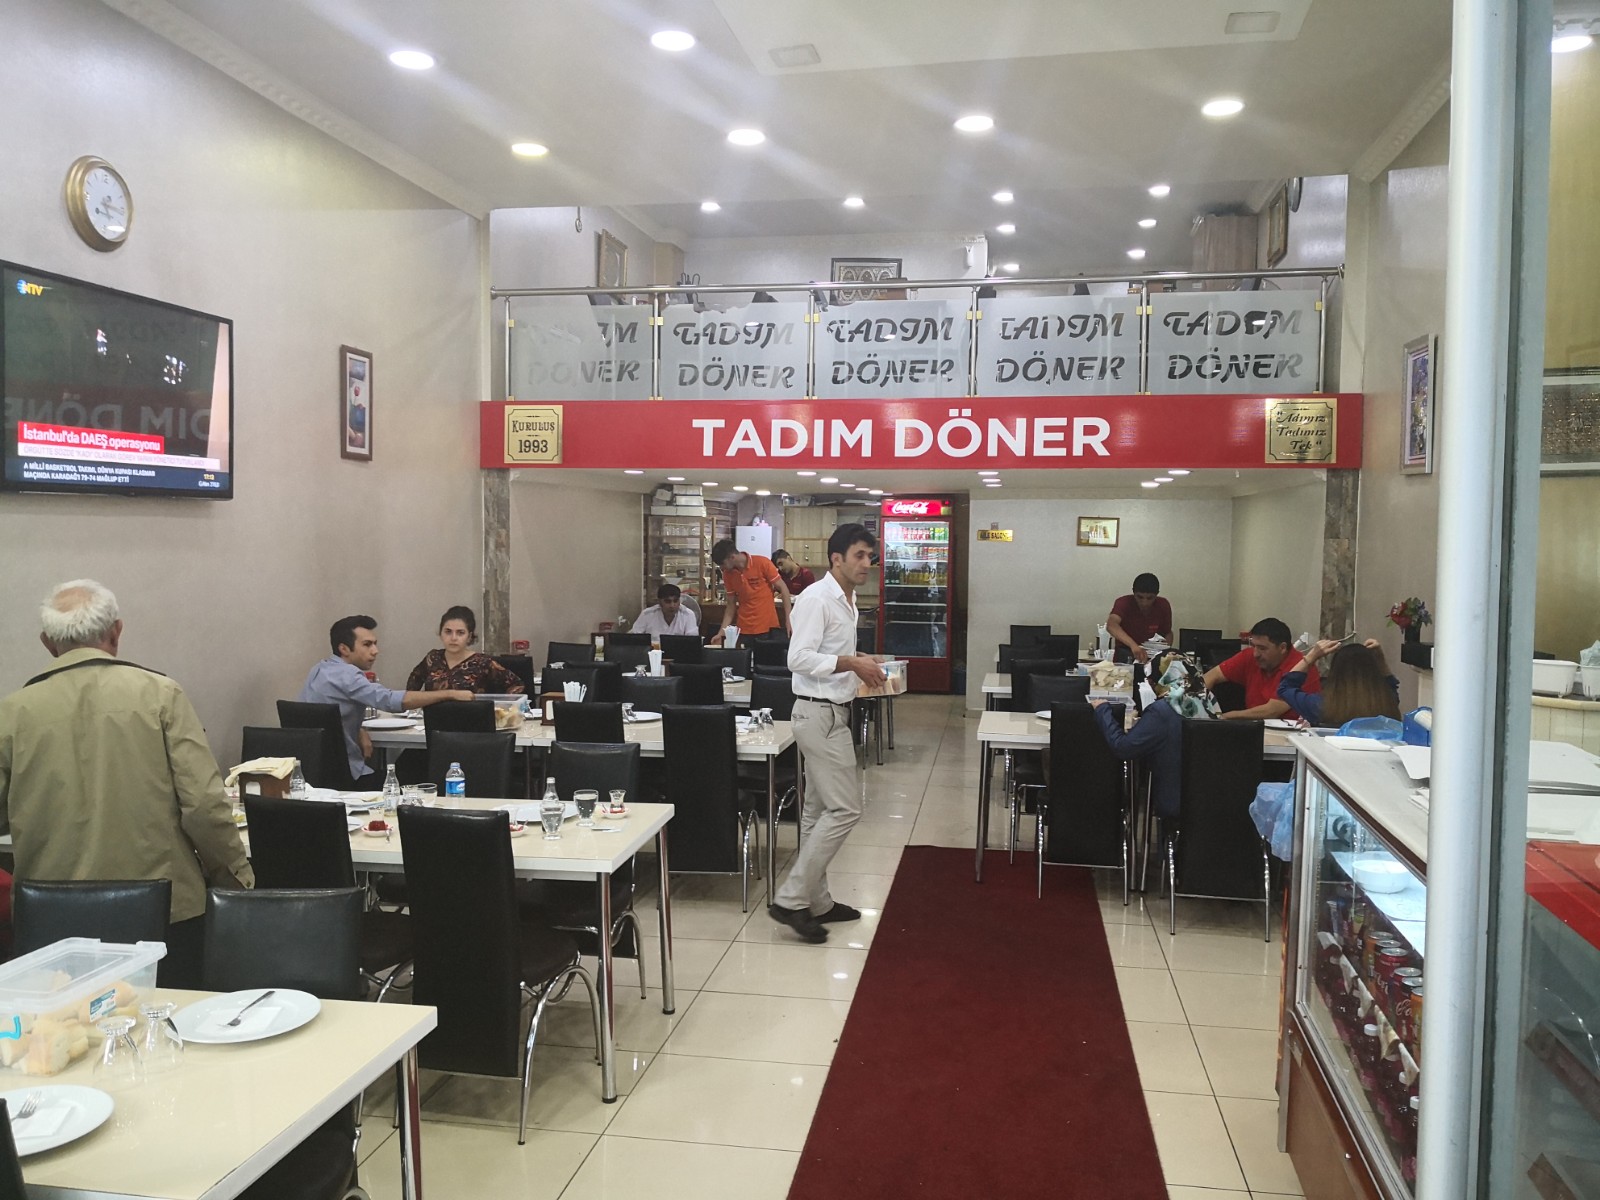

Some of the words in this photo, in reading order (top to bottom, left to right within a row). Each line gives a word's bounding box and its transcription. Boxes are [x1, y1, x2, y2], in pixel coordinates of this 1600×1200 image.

[673, 321, 794, 349] TADIM
[826, 316, 955, 344] TADIM
[999, 312, 1125, 343] TADIM
[1163, 309, 1303, 339] TADIM
[678, 356, 796, 391] DÖNER
[831, 353, 955, 388] DÖNER
[996, 350, 1126, 385] DÖNER
[1167, 346, 1303, 384] DÖNER
[24, 423, 80, 443] İstanbul'da
[81, 432, 107, 449] DAEŞ
[109, 437, 160, 452] operasyonu
[518, 439, 548, 453] 1993
[692, 418, 872, 458] TADIM
[893, 408, 1111, 457] DÖNER
[29, 461, 45, 470] MİLLİ
[891, 501, 930, 514] Coca-Cola
